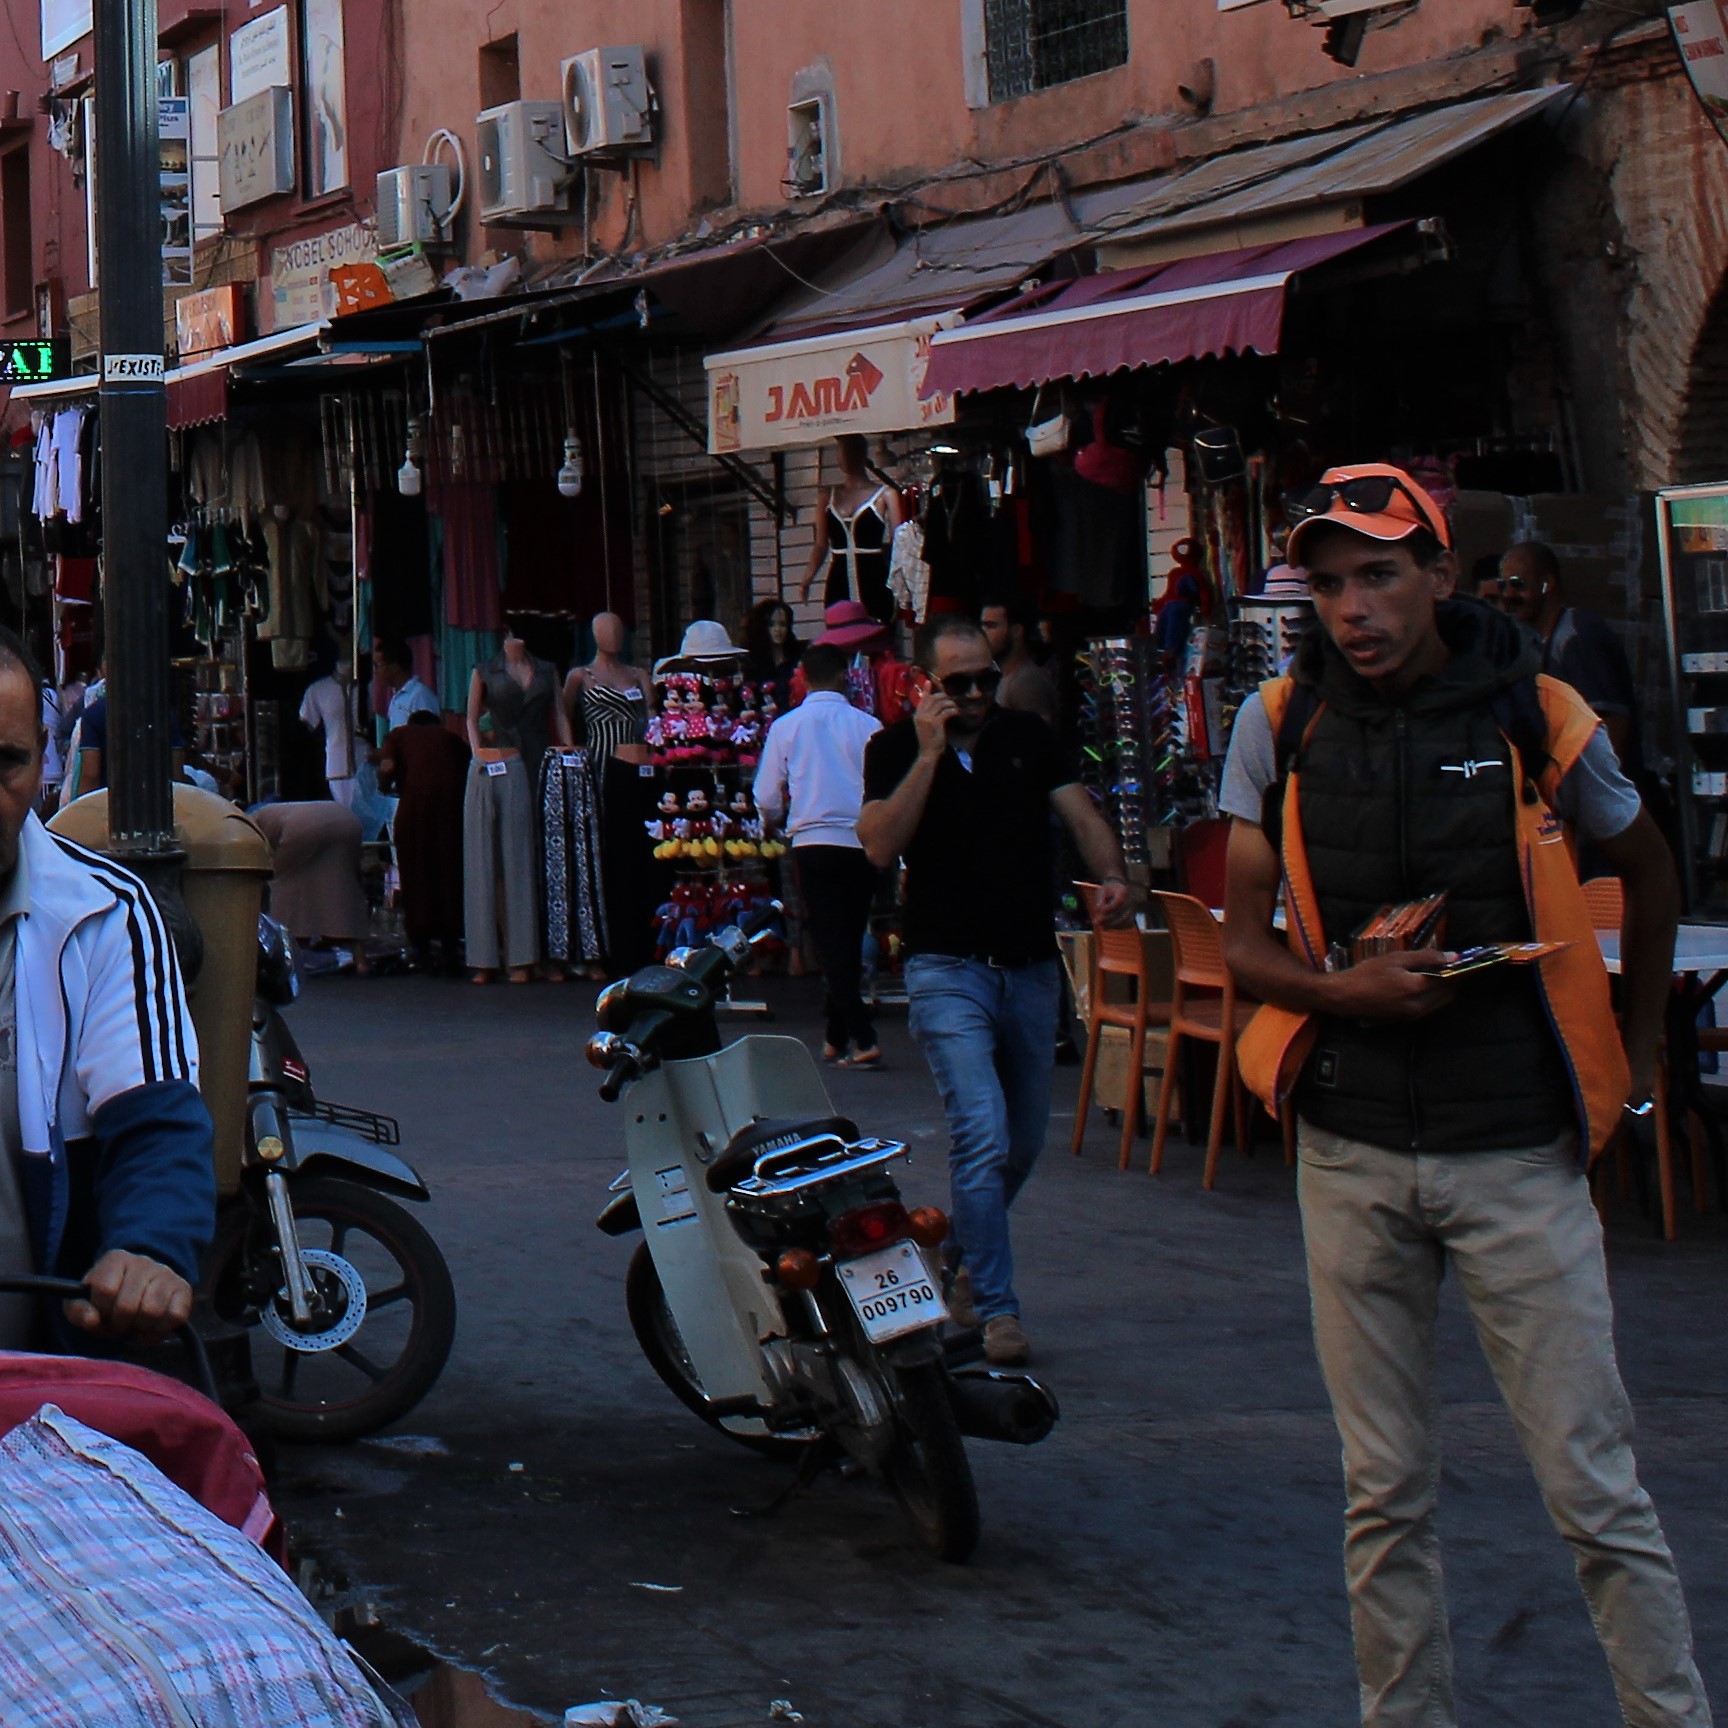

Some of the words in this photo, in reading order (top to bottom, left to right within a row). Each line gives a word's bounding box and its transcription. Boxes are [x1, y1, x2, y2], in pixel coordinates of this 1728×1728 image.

[764, 370, 870, 423] JAMA
[751, 1131, 802, 1157] YAMAHA
[874, 1270, 899, 1290] 26
[861, 1285, 935, 1322] 009790
